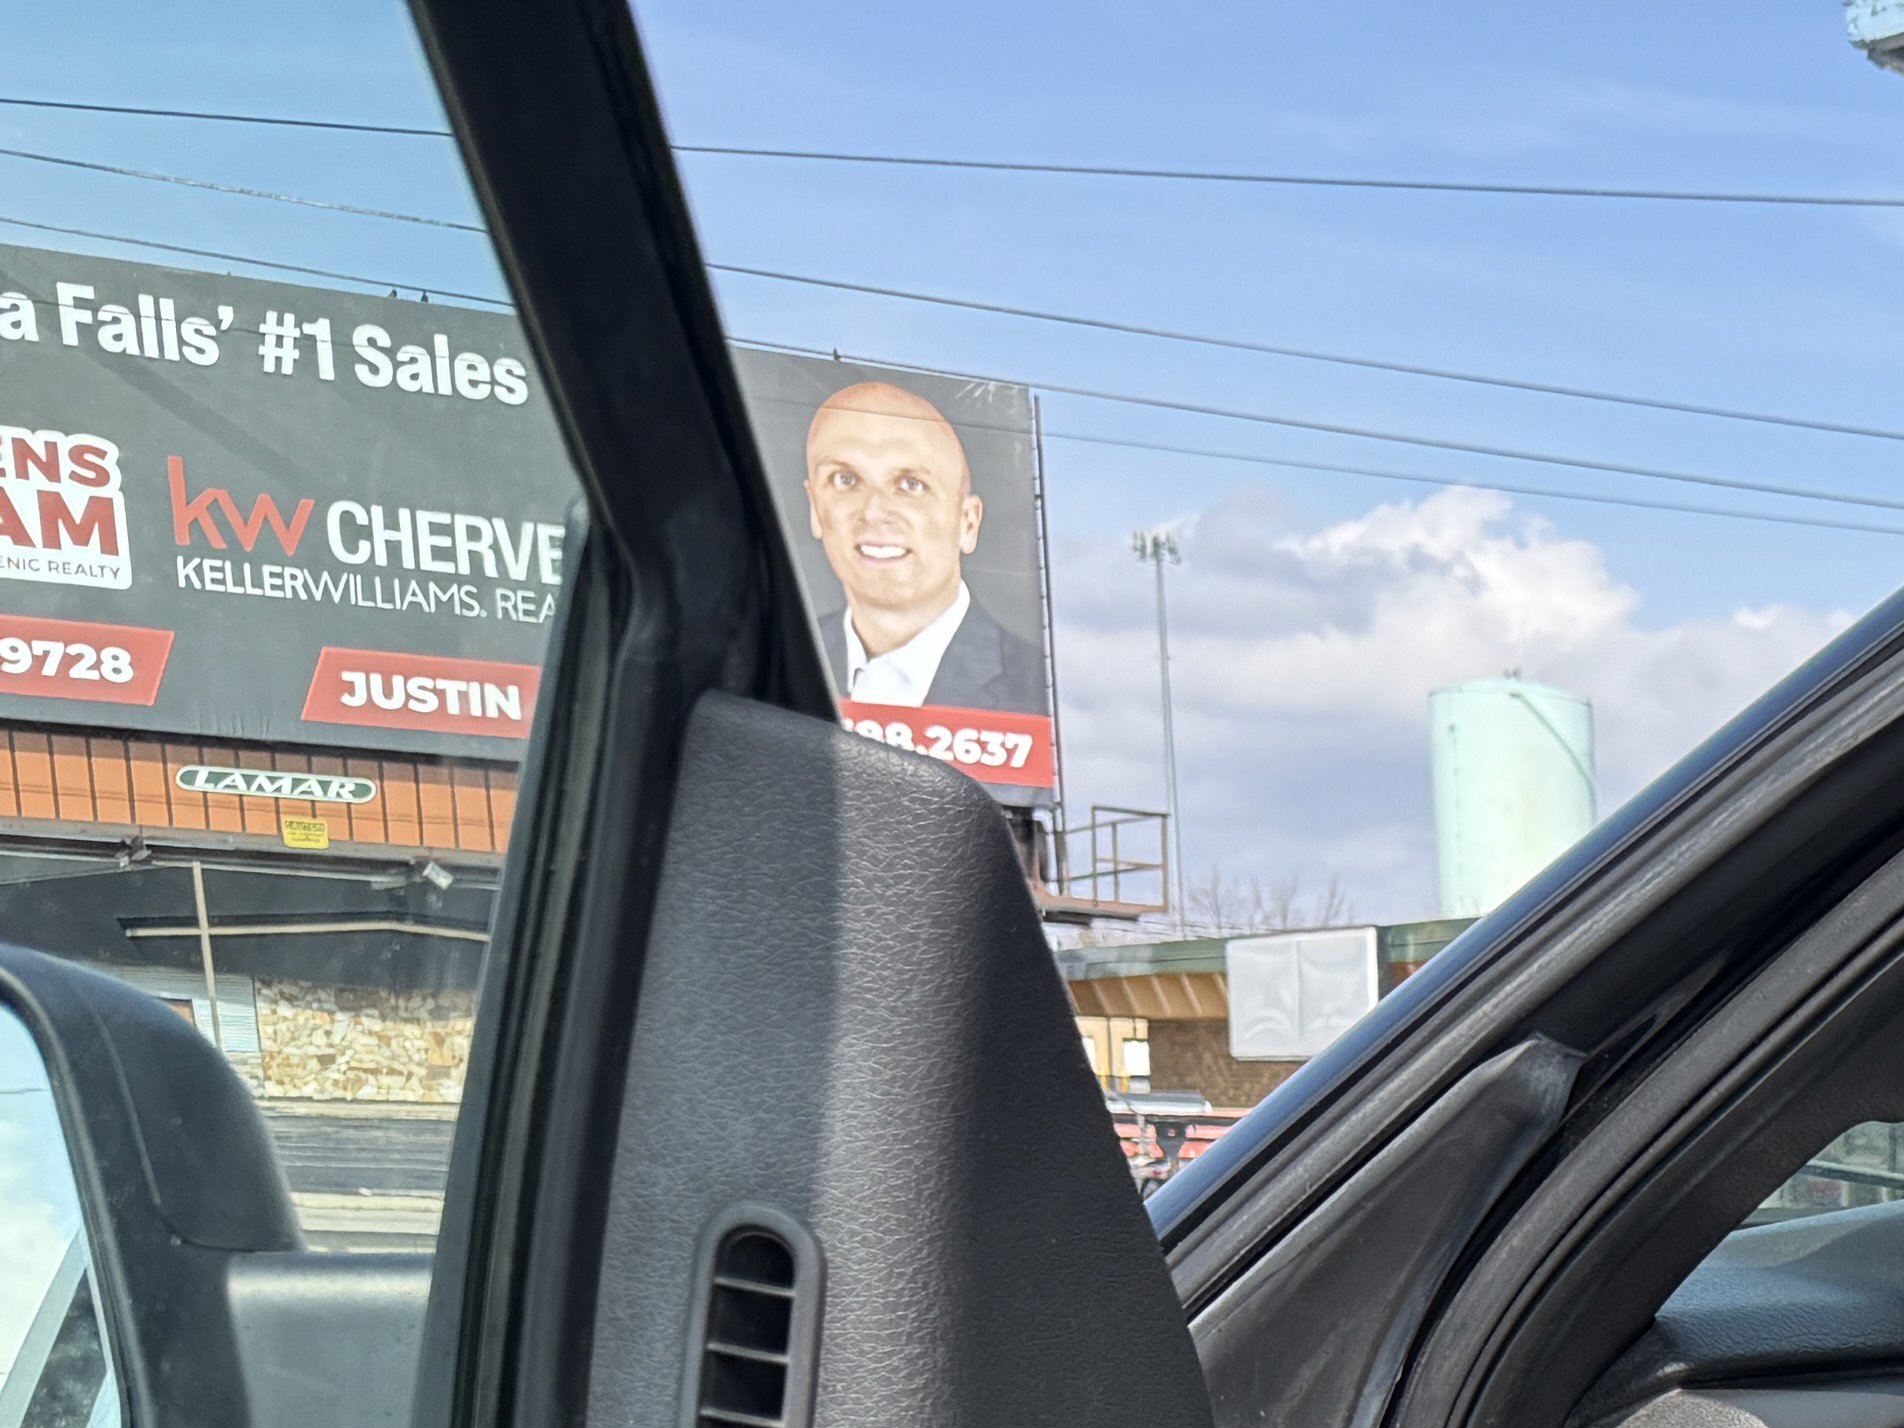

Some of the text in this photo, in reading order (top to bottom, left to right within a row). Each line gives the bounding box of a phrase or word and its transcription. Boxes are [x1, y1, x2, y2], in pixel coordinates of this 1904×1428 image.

[258, 310, 335, 381] #1
[352, 324, 529, 405] Sales
[0, 437, 111, 488] NS
[167, 455, 315, 556] kw
[47, 560, 120, 580] REALTY
[0, 637, 134, 683] 9728
[340, 671, 522, 720] JUSTIN
[194, 769, 356, 800] LAMAR
